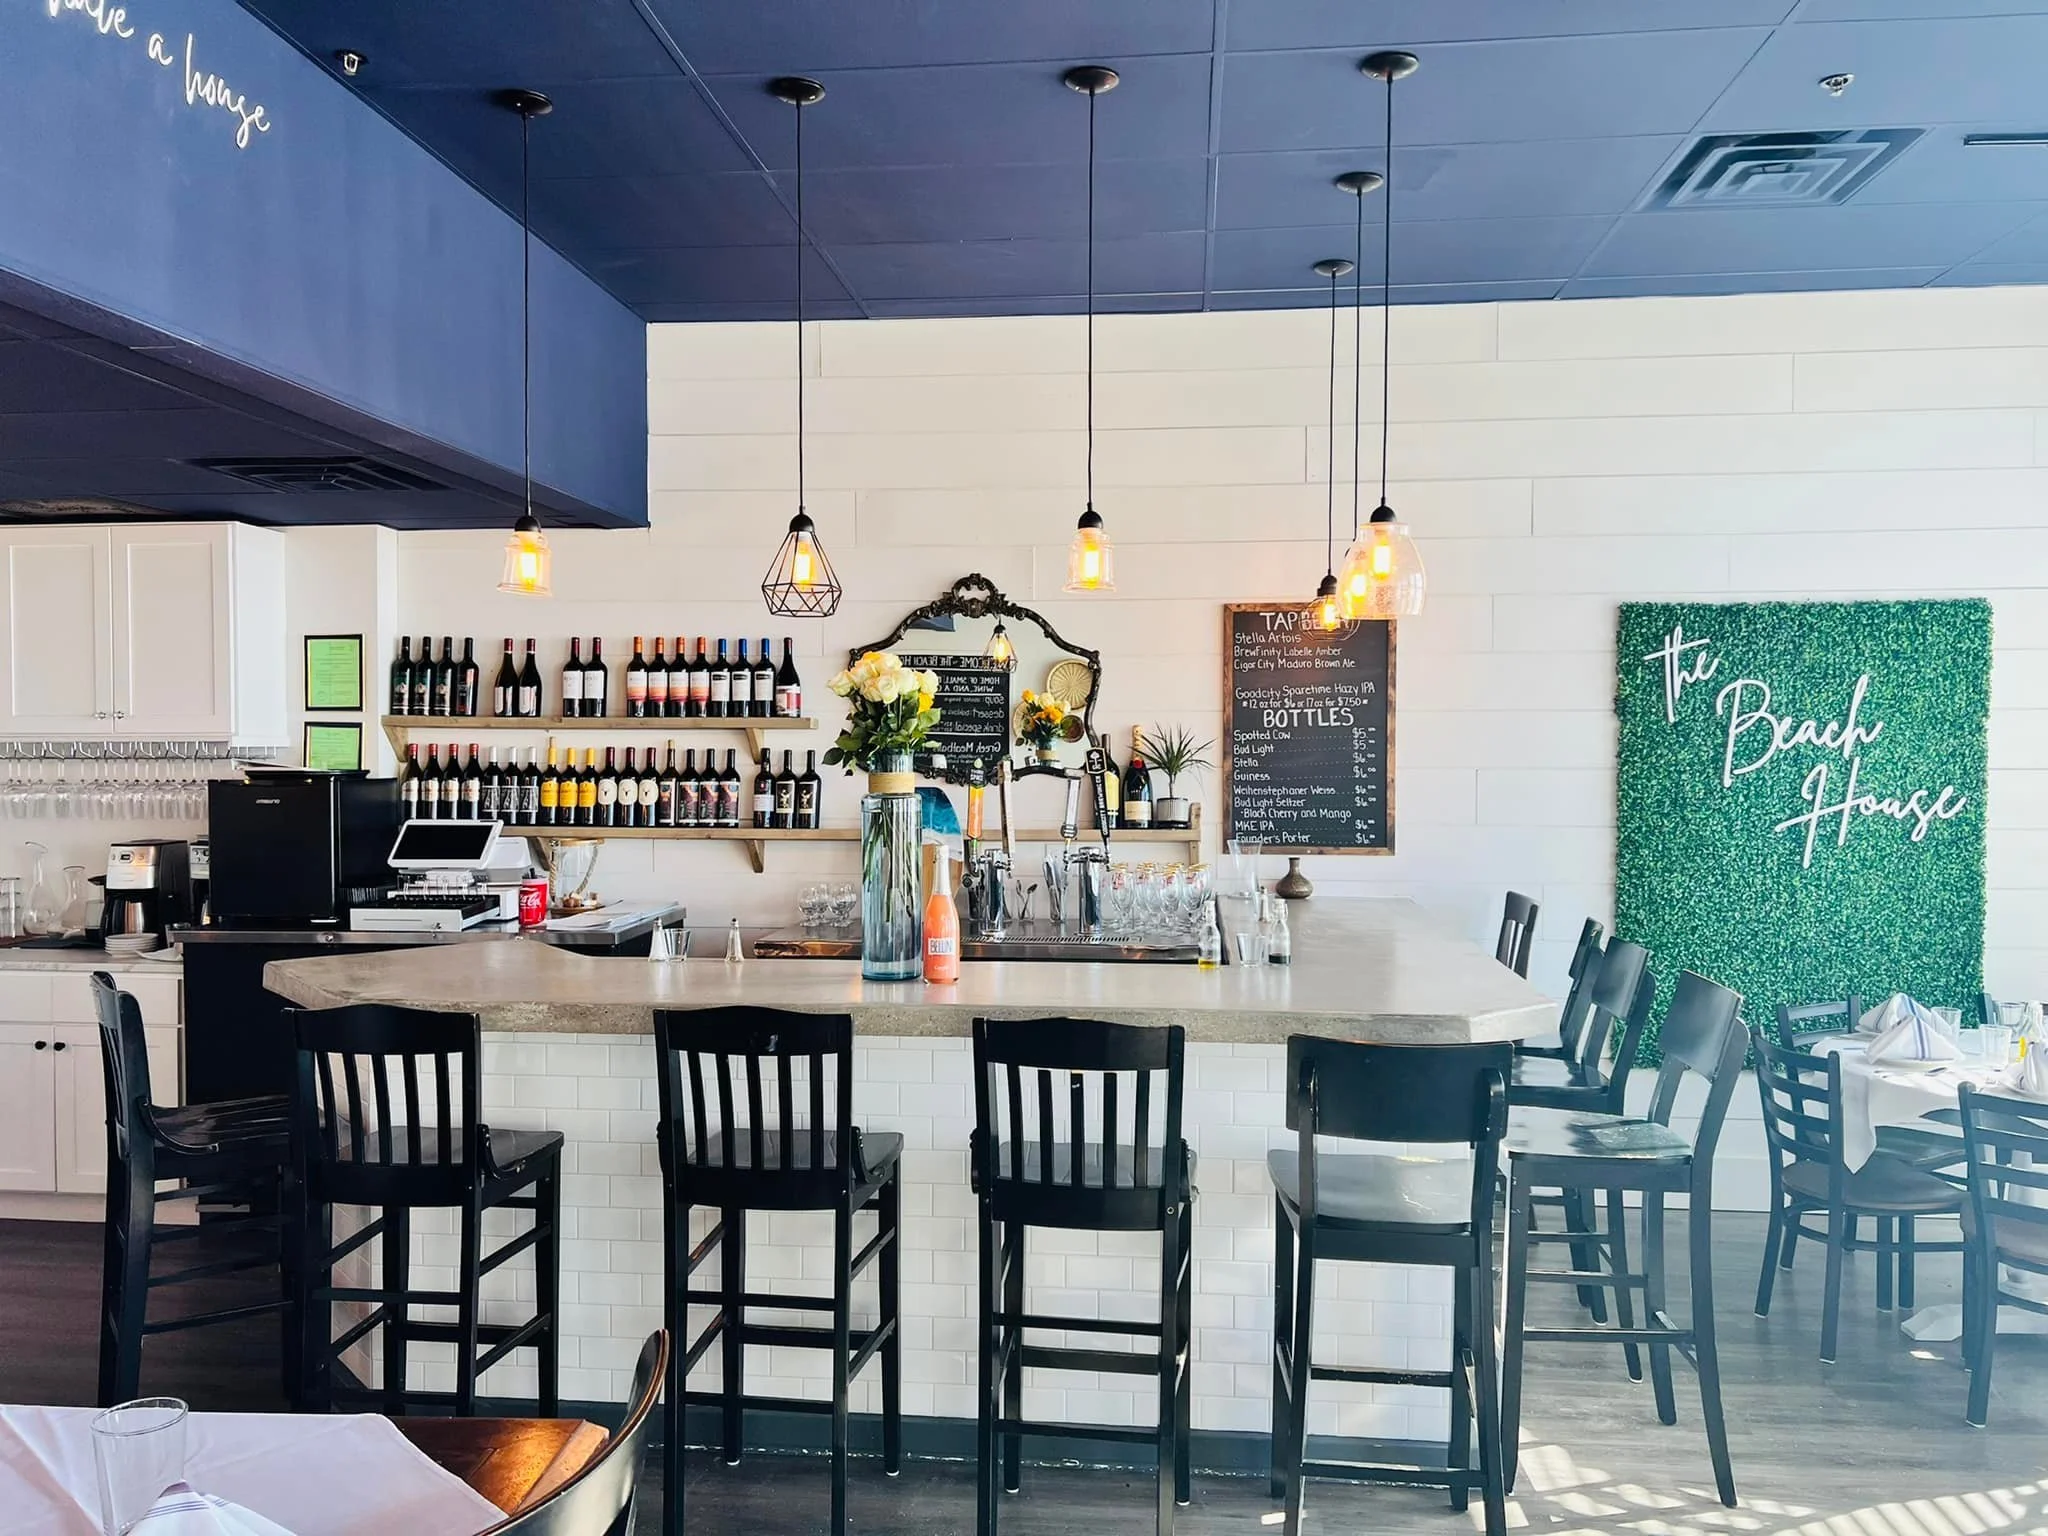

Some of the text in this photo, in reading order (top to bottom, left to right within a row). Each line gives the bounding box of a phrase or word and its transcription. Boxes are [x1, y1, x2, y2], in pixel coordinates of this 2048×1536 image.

[149, 33, 173, 65] a
[186, 33, 270, 149] house
[1259, 612, 1298, 631] TAP
[1235, 632, 1302, 644] Stella Artois
[1315, 645, 1342, 656] Amber
[1234, 657, 1356, 672] Cigar City Maduro Brown Ale
[1644, 625, 1719, 723] the
[1334, 682, 1359, 696] Hazy
[1361, 681, 1376, 694] IPA
[1270, 698, 1282, 708] for
[1325, 697, 1336, 706] for
[1263, 707, 1354, 728] BOTTLES
[1233, 730, 1271, 744] Spotted
[1272, 729, 1291, 740] Cow
[1716, 674, 1883, 787] Beach
[1233, 744, 1250, 755] Bud
[1252, 743, 1274, 757] Light
[1233, 757, 1259, 768] Stella
[1234, 796, 1251, 807] Bud
[1252, 797, 1274, 811] Light
[1275, 797, 1307, 807] Seltzer
[1268, 808, 1298, 821] Cherry
[1300, 808, 1317, 818] and
[1319, 807, 1352, 824] Mango
[1774, 756, 1966, 868] House
[1235, 820, 1258, 831] MKE
[1259, 820, 1275, 831] IPA
[1282, 831, 1312, 843] Porter
